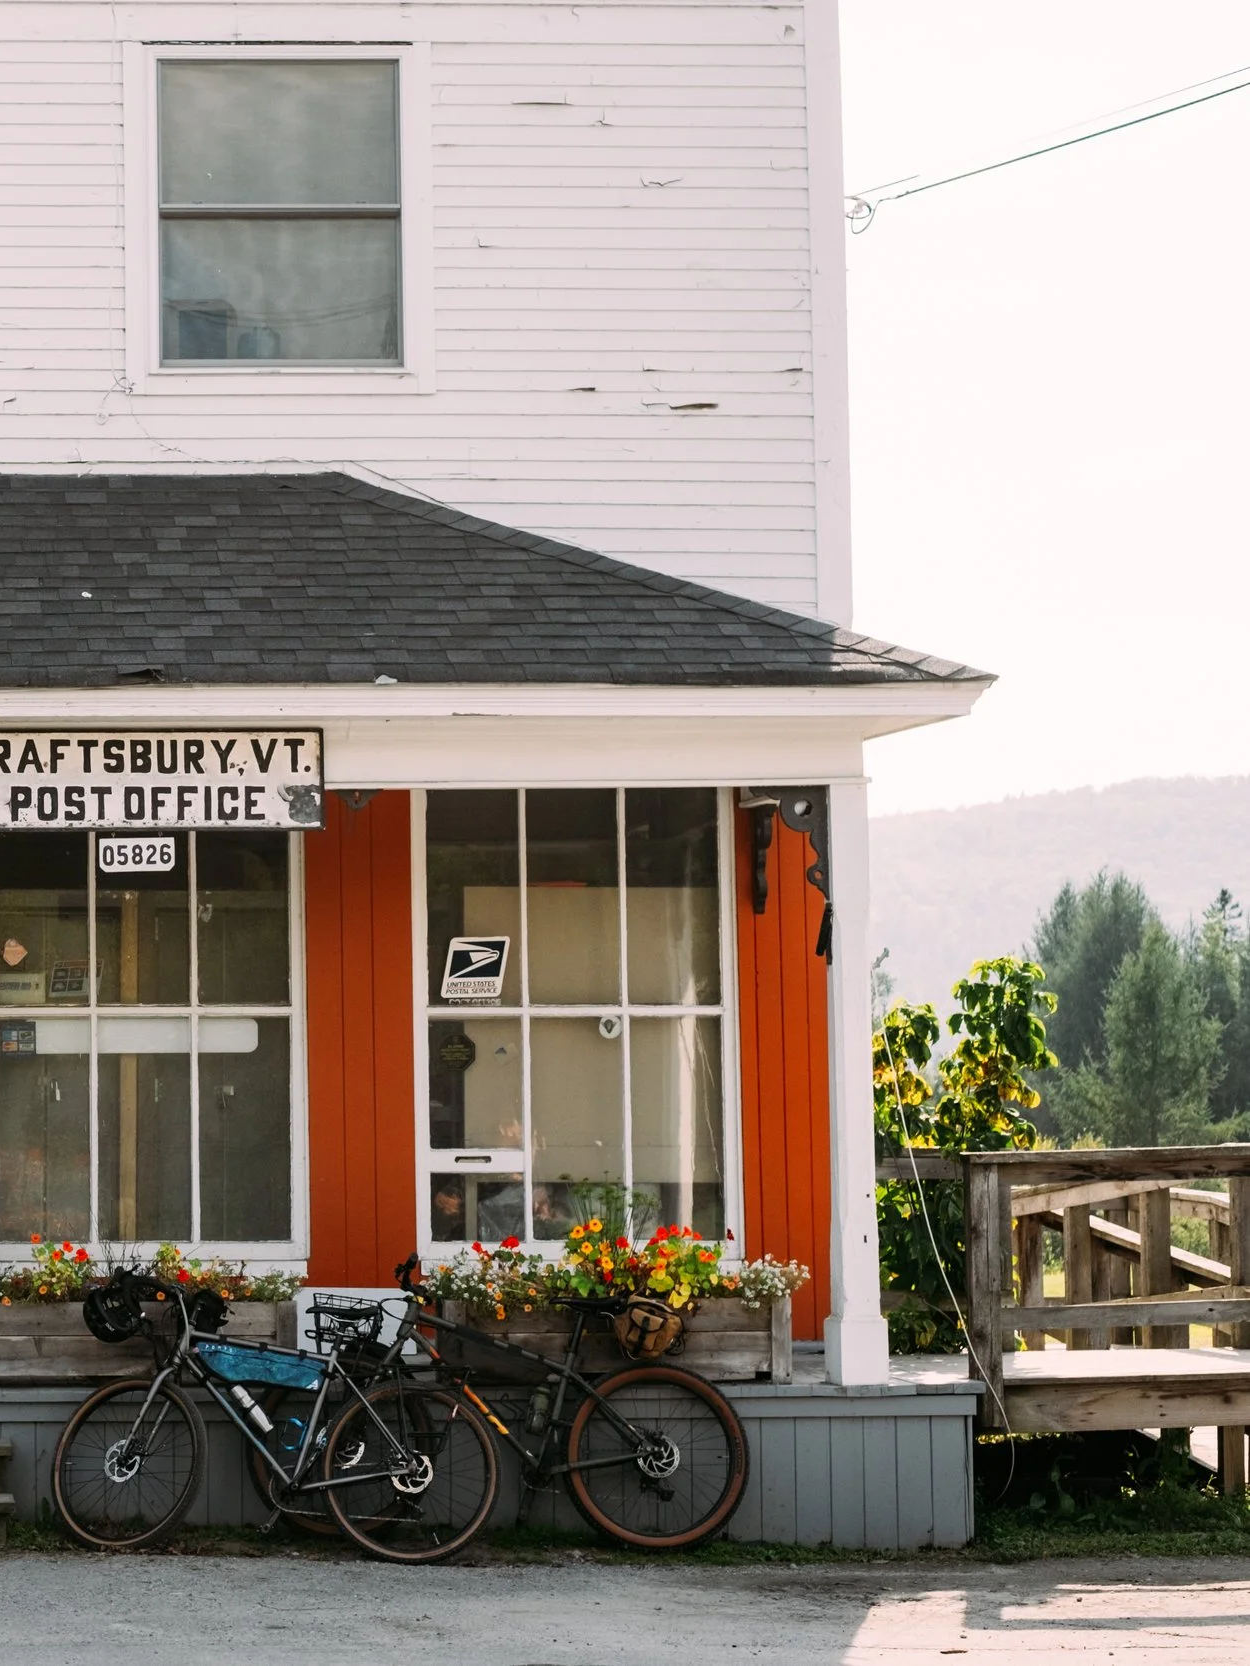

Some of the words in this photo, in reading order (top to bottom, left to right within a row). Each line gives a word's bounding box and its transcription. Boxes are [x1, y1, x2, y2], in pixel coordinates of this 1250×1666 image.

[249, 738, 312, 773] VT.
[10, 786, 112, 822] POST
[123, 786, 266, 821] OFFICE
[102, 843, 172, 866] 05826
